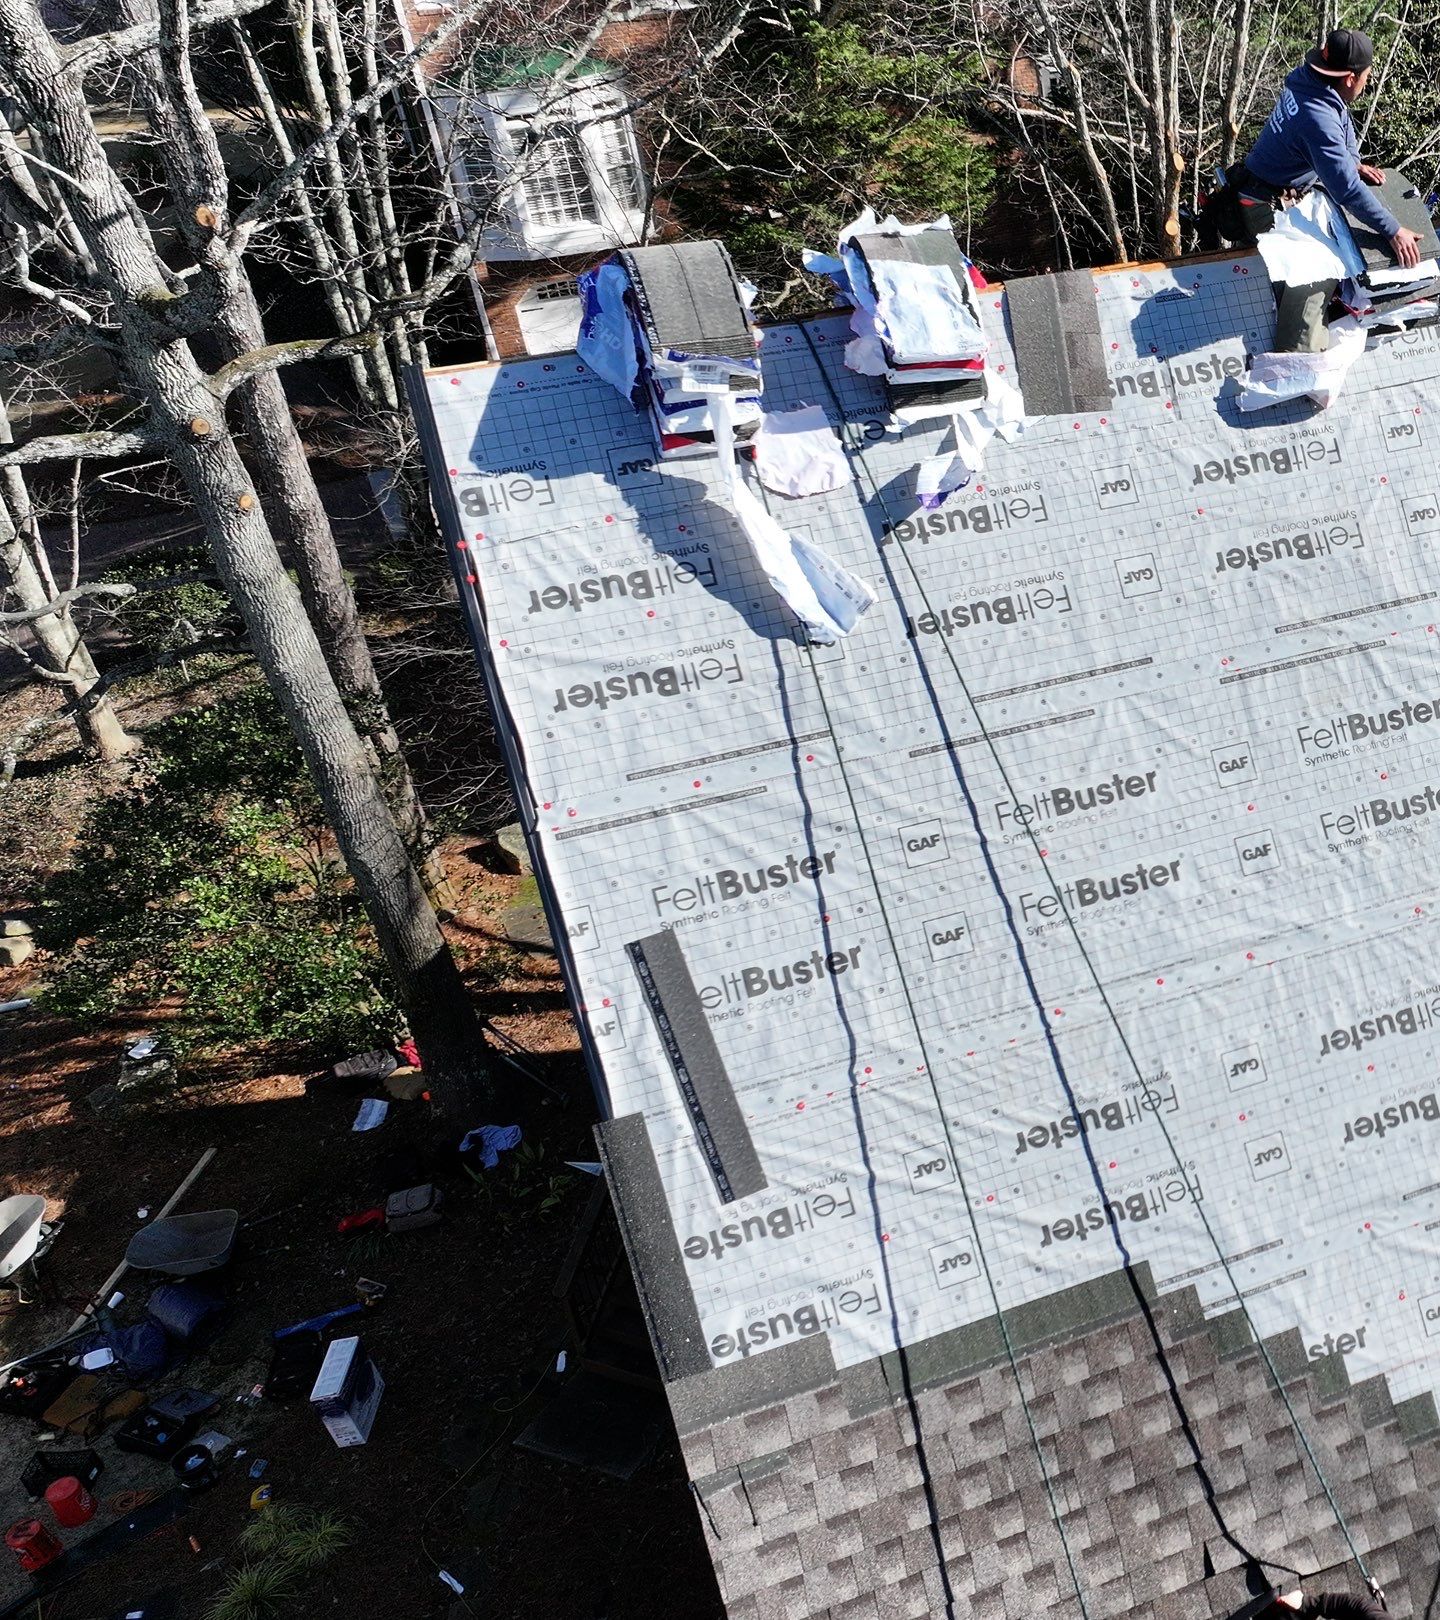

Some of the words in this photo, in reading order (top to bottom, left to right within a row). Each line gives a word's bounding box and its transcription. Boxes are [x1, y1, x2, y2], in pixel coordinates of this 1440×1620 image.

[1391, 346, 1436, 360] Synthetic
[1289, 425, 1335, 441] Synthetic
[1386, 424, 1415, 439] GAF
[616, 459, 653, 478] GAF
[1193, 438, 1342, 486] FeltBuster
[989, 480, 1041, 498] Synthetic
[1100, 478, 1130, 495] GAF
[881, 494, 1049, 546] FeltBuster
[1310, 510, 1358, 528] Synthetic
[1409, 507, 1437, 523] GAF
[651, 542, 711, 562] Synthetic
[1215, 522, 1365, 574] FeltBuster
[527, 557, 718, 615] FeltBuster
[1011, 571, 1065, 591] Synthetic
[1123, 566, 1154, 584] GAF
[908, 585, 1072, 638] FeltBuster
[677, 639, 735, 659] Synthetic
[553, 653, 745, 713] FeltBuster
[1304, 749, 1350, 767] Synthetic
[1353, 738, 1390, 756] Roofing
[1219, 756, 1249, 775] GAF
[996, 769, 1157, 830] FeltBuster
[907, 834, 941, 853] GAF
[1328, 835, 1373, 853] Synthetic
[1376, 824, 1413, 842] Roofing
[1242, 844, 1272, 863] GAF
[651, 850, 836, 917] FeltBuster
[1019, 858, 1181, 921] FeltBuster
[660, 909, 719, 931] Synthetic
[722, 896, 769, 917] Roofing
[932, 927, 965, 946] GAF
[1230, 1058, 1260, 1078] GAF
[1015, 1084, 1179, 1155] FeltBuster
[914, 1158, 948, 1179] GAF
[1253, 1147, 1283, 1168] GAF
[791, 1171, 848, 1197] Synthetic
[1040, 1174, 1203, 1248] FeltBuster
[684, 1186, 856, 1260] FeltBuste
[937, 1251, 972, 1275] GAF
[817, 1267, 875, 1293] Synthetic
[711, 1283, 882, 1358] FeltBuste
